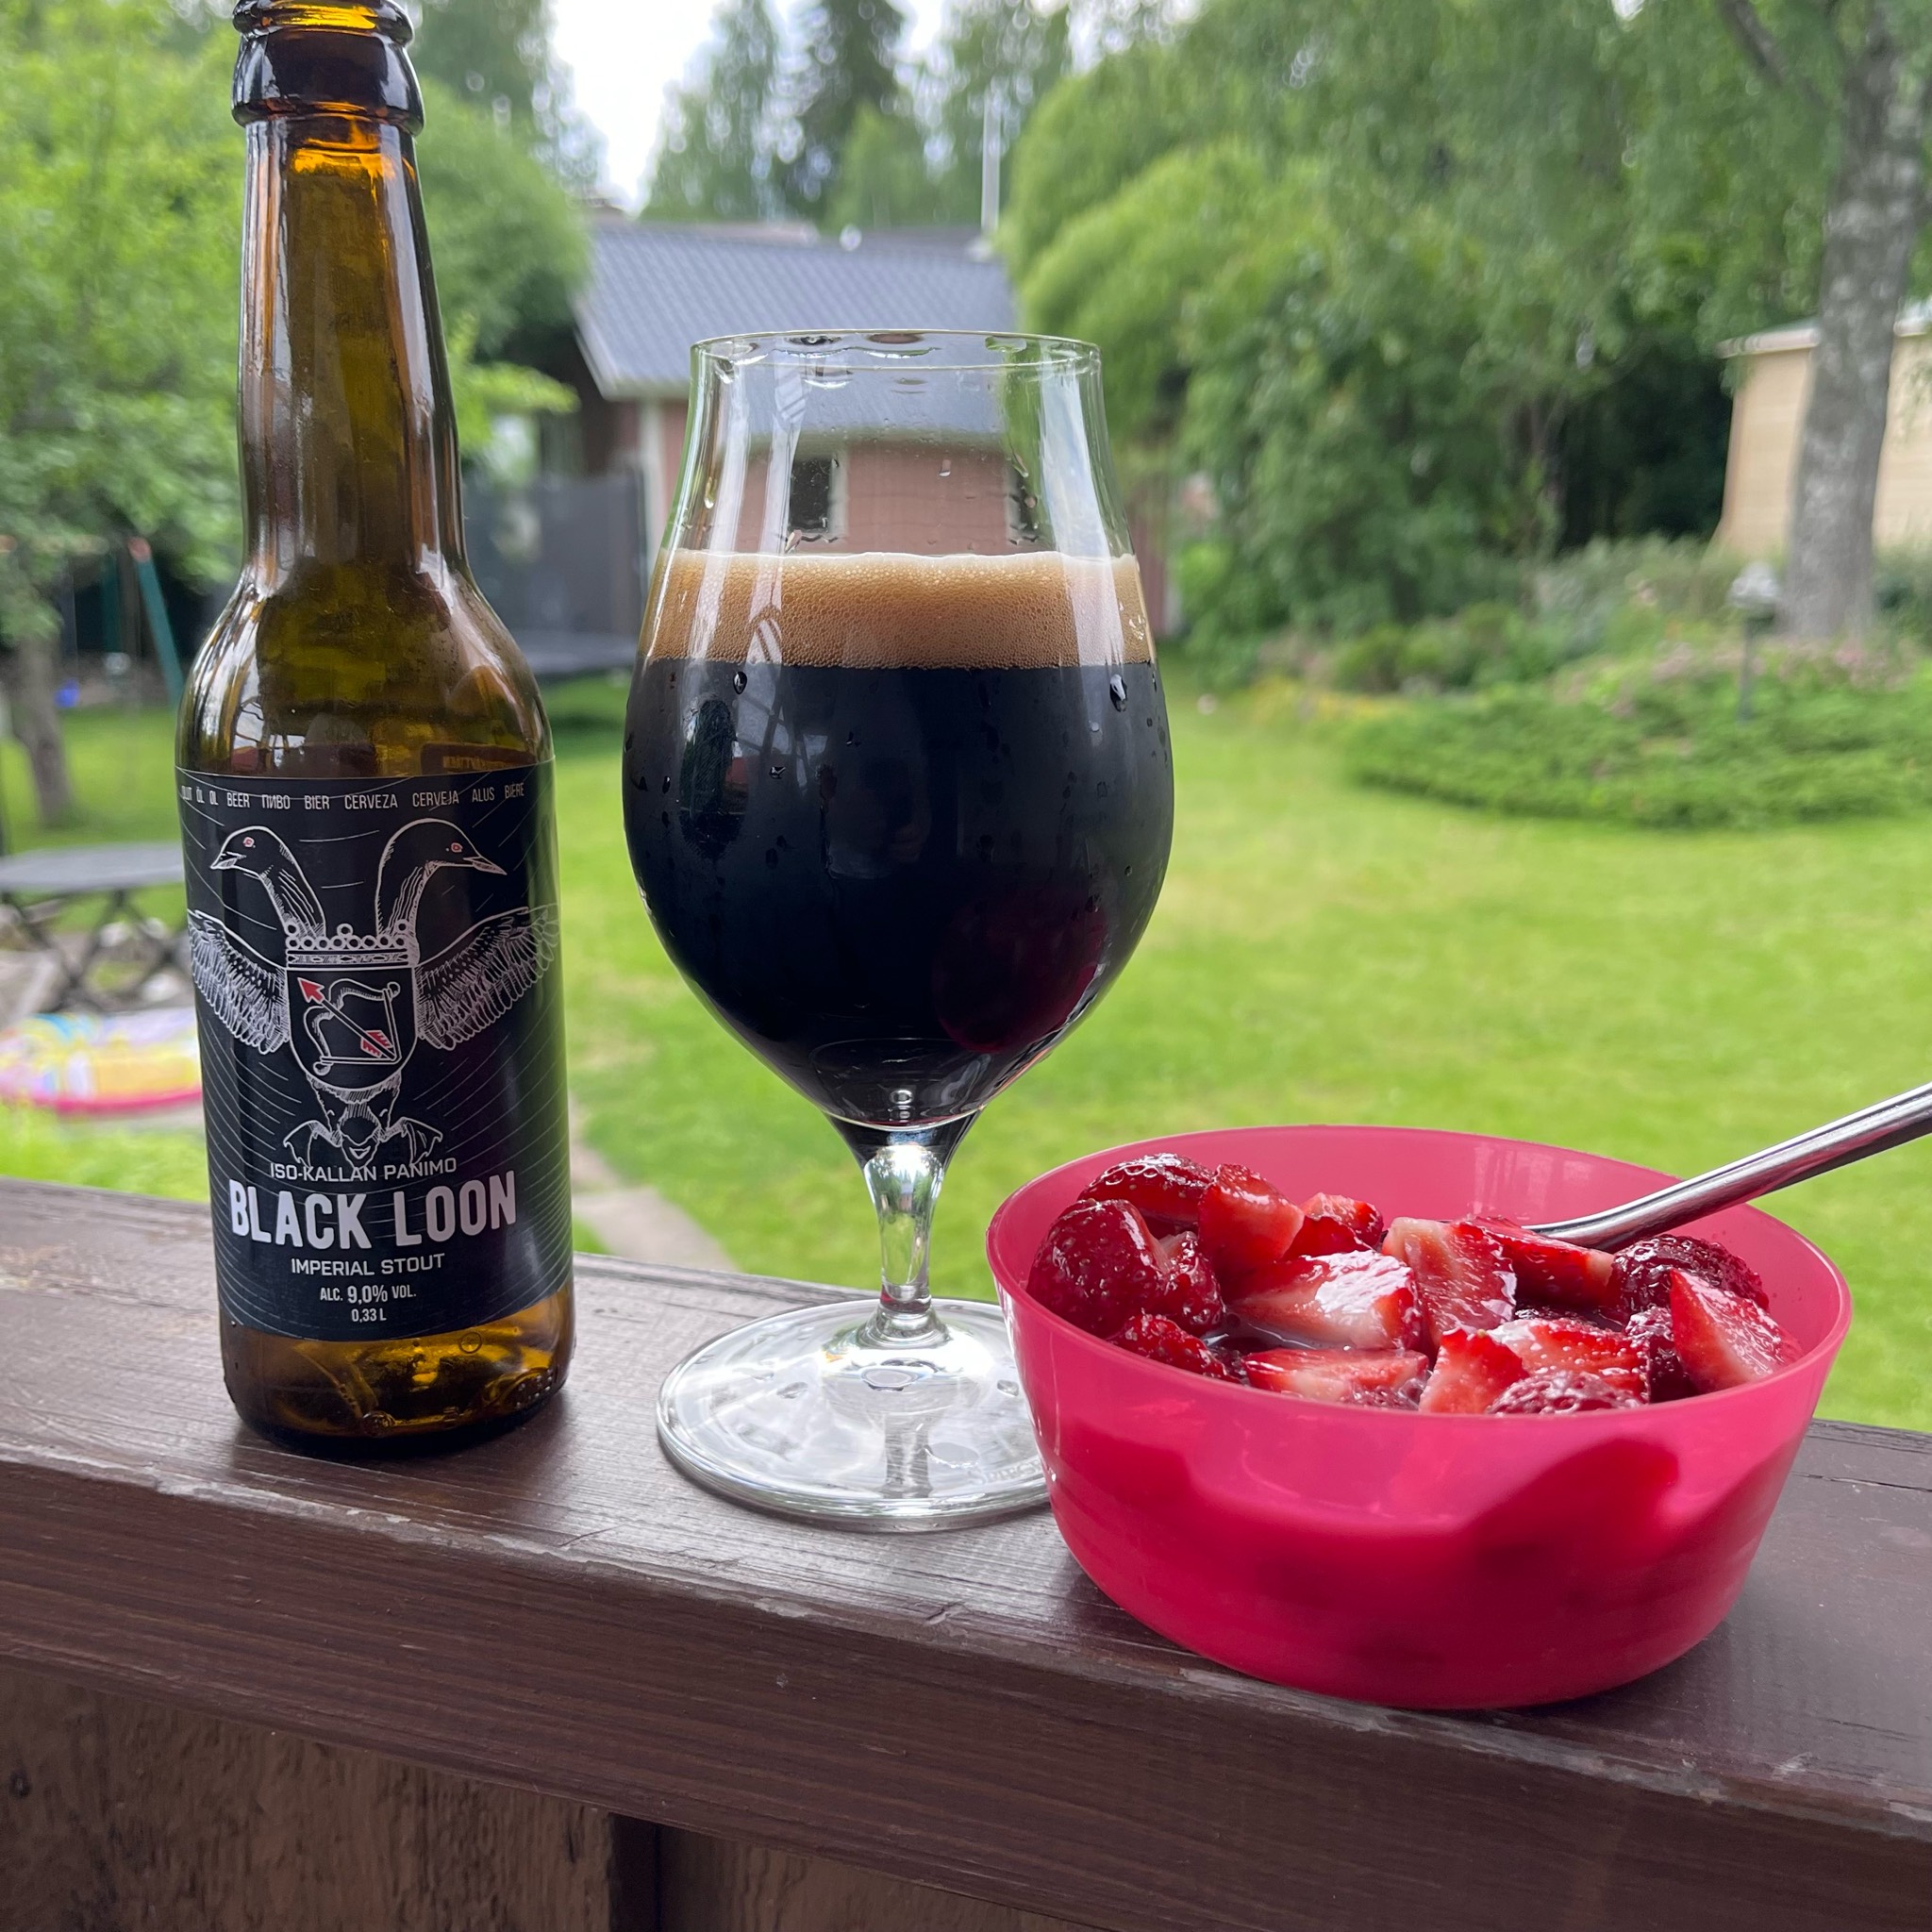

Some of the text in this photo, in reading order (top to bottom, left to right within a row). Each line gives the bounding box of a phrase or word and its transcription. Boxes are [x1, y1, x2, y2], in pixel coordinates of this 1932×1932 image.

[226, 791, 250, 808] BEER
[304, 794, 330, 809] BIER
[344, 794, 398, 809] CERVEZA
[412, 791, 459, 808] CERVEJA
[472, 786, 494, 803] ALUS
[383, 1157, 457, 1180] PANIMO
[228, 1170, 517, 1249] BLACK LOON
[291, 1253, 444, 1276] IMPERIAL STOUT
[320, 1284, 417, 1305] ALC. 9,0% VOL.
[351, 1307, 387, 1324] 0,33 L
